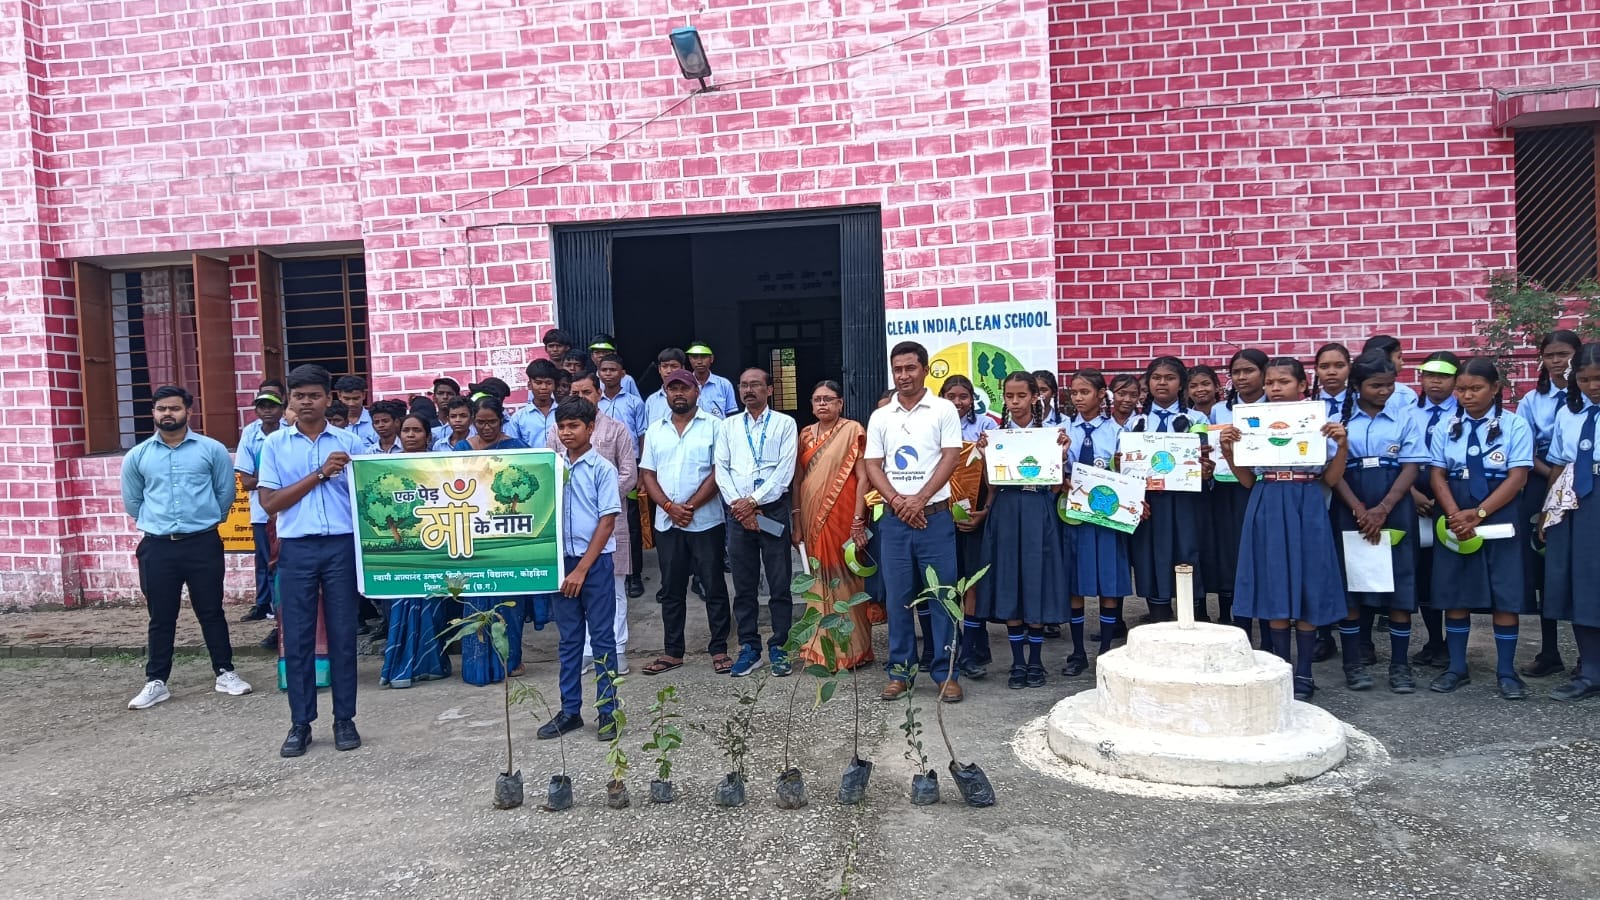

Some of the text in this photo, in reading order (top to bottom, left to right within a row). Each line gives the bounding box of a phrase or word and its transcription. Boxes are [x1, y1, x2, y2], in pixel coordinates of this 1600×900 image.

[887, 320, 919, 335] CLEAN
[1004, 311, 1052, 329] SCHOOL
[394, 485, 439, 504] एक पेड़
[415, 478, 479, 557] माँ
[474, 514, 532, 534] के नाम
